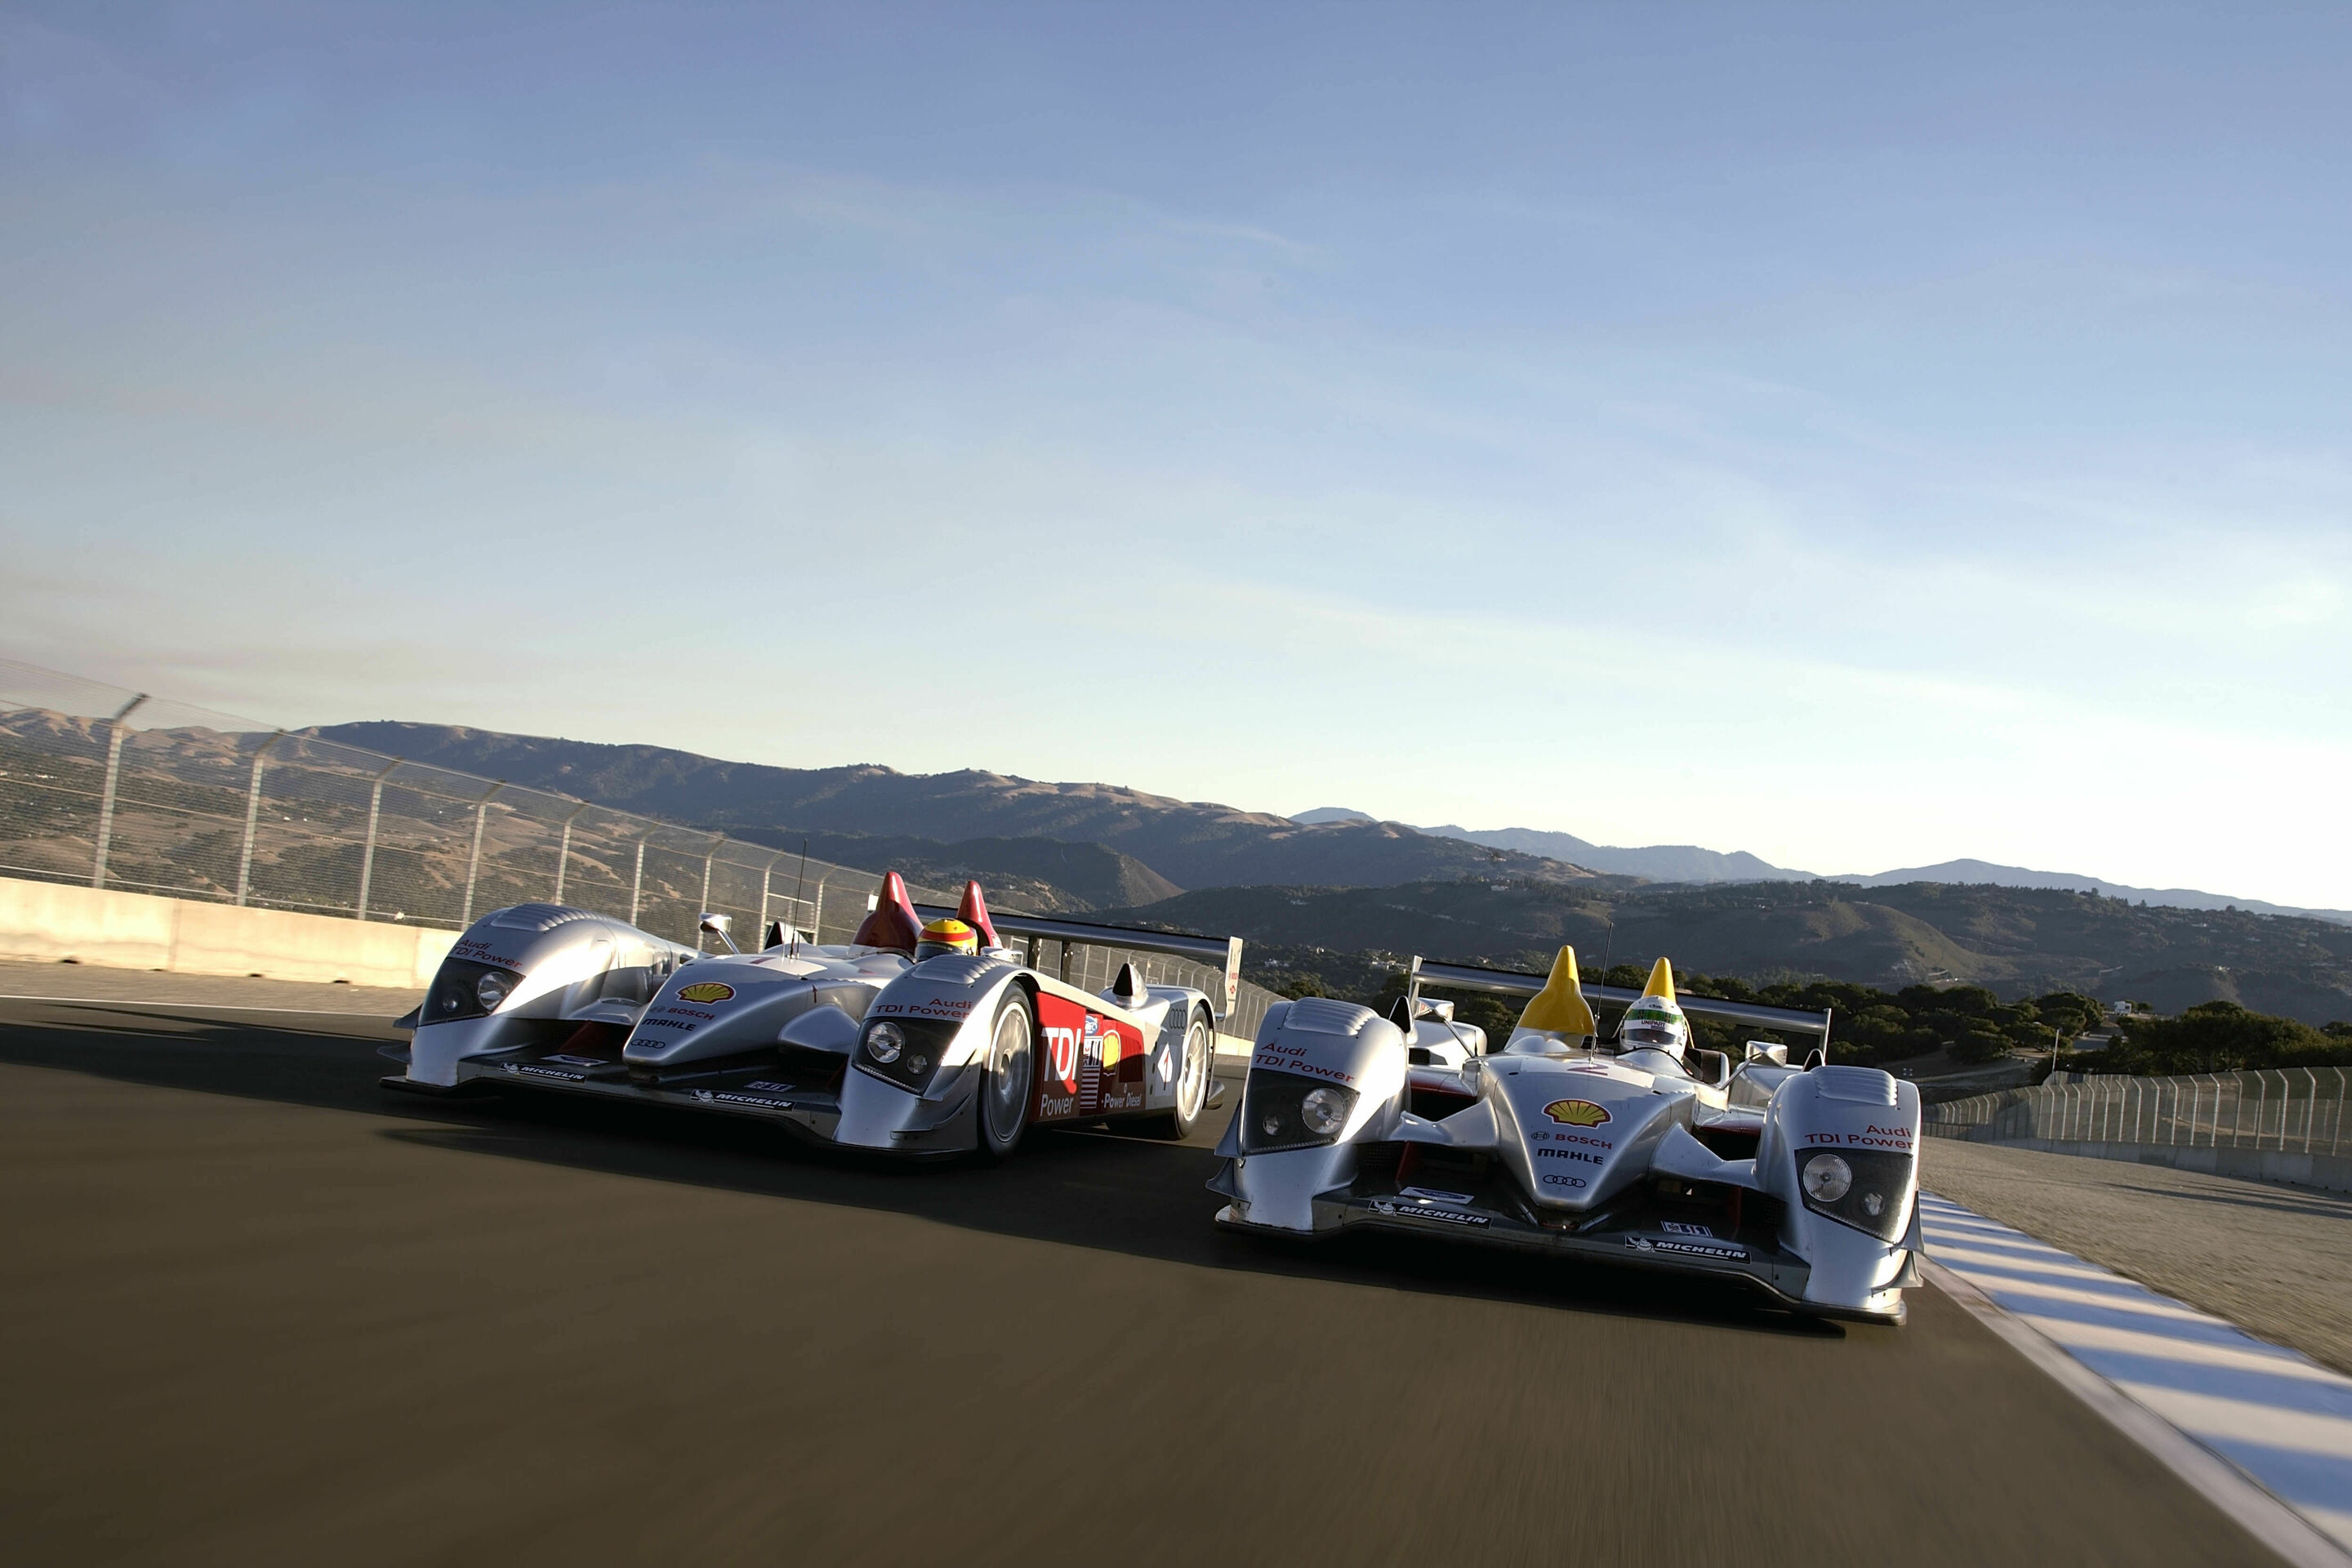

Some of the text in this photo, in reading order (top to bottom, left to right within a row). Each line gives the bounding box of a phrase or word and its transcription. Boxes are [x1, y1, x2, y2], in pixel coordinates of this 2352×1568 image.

[458, 939, 492, 950] Audi
[473, 950, 523, 967] Power
[929, 998, 972, 1009] Audi
[668, 1007, 715, 1020] BOSCH
[875, 1004, 969, 1018] TDI Power
[641, 1018, 697, 1031] MAHLE
[1041, 1027, 1082, 1081] TDI
[1261, 1043, 1307, 1057] Audi
[521, 1066, 585, 1080] MICHELIN
[1256, 1054, 1355, 1082] TDI Power
[715, 1094, 792, 1107] MICHELIN
[1040, 1094, 1074, 1116] Power
[1125, 1093, 1143, 1107] Diesel
[1866, 1125, 1912, 1138] Audi
[1555, 1134, 1613, 1150] BOSCH
[1804, 1134, 1914, 1149] TDI Power
[1537, 1148, 1604, 1165] MAHLE
[1399, 1205, 1489, 1223] MICHELIN
[1656, 1241, 1746, 1258] MICHELIN
